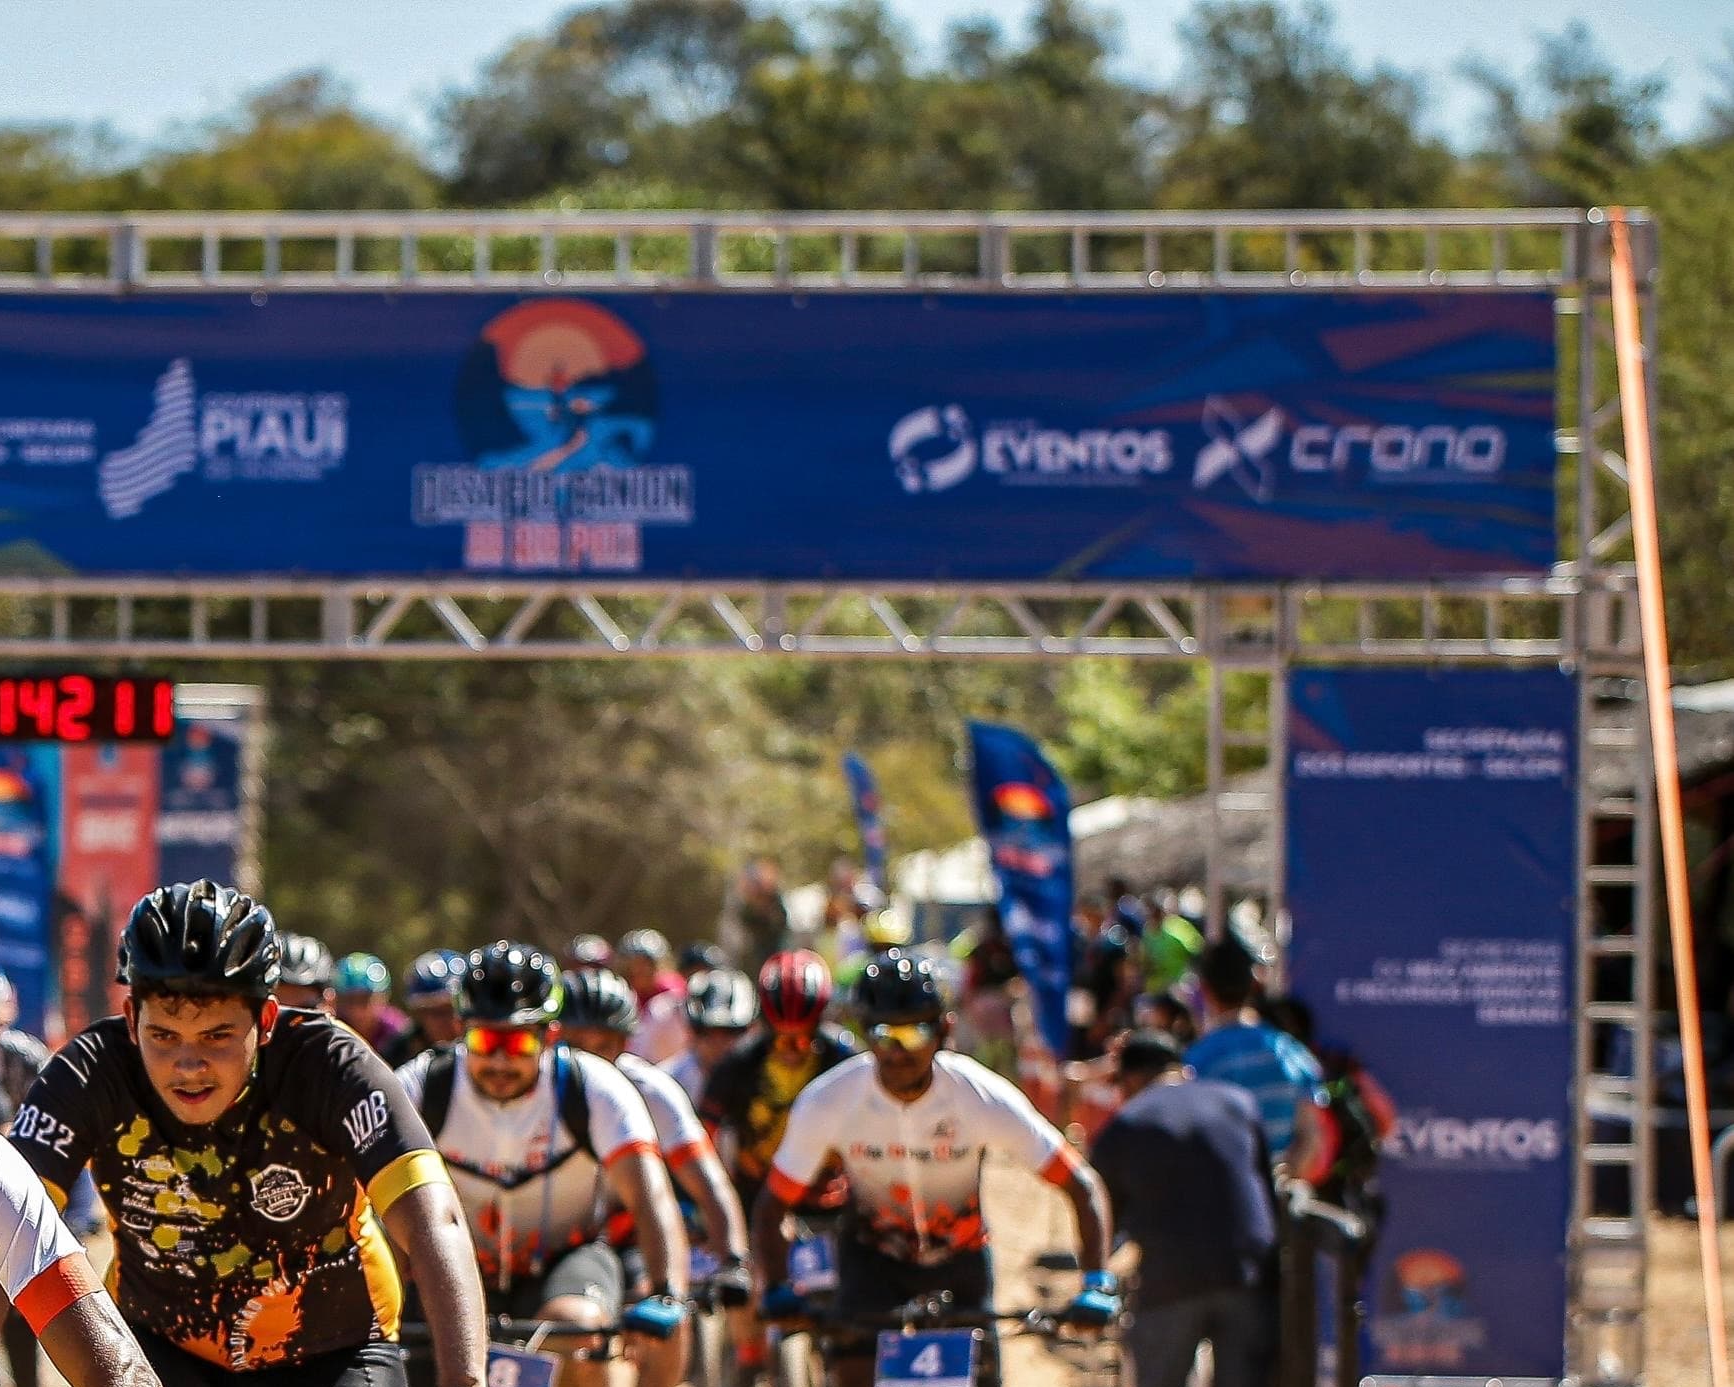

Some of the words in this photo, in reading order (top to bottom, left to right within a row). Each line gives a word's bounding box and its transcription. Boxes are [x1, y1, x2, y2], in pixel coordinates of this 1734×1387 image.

[984, 429, 1170, 473] EVENTOS
[1290, 425, 1505, 472] crono
[910, 1342, 943, 1377] 4
